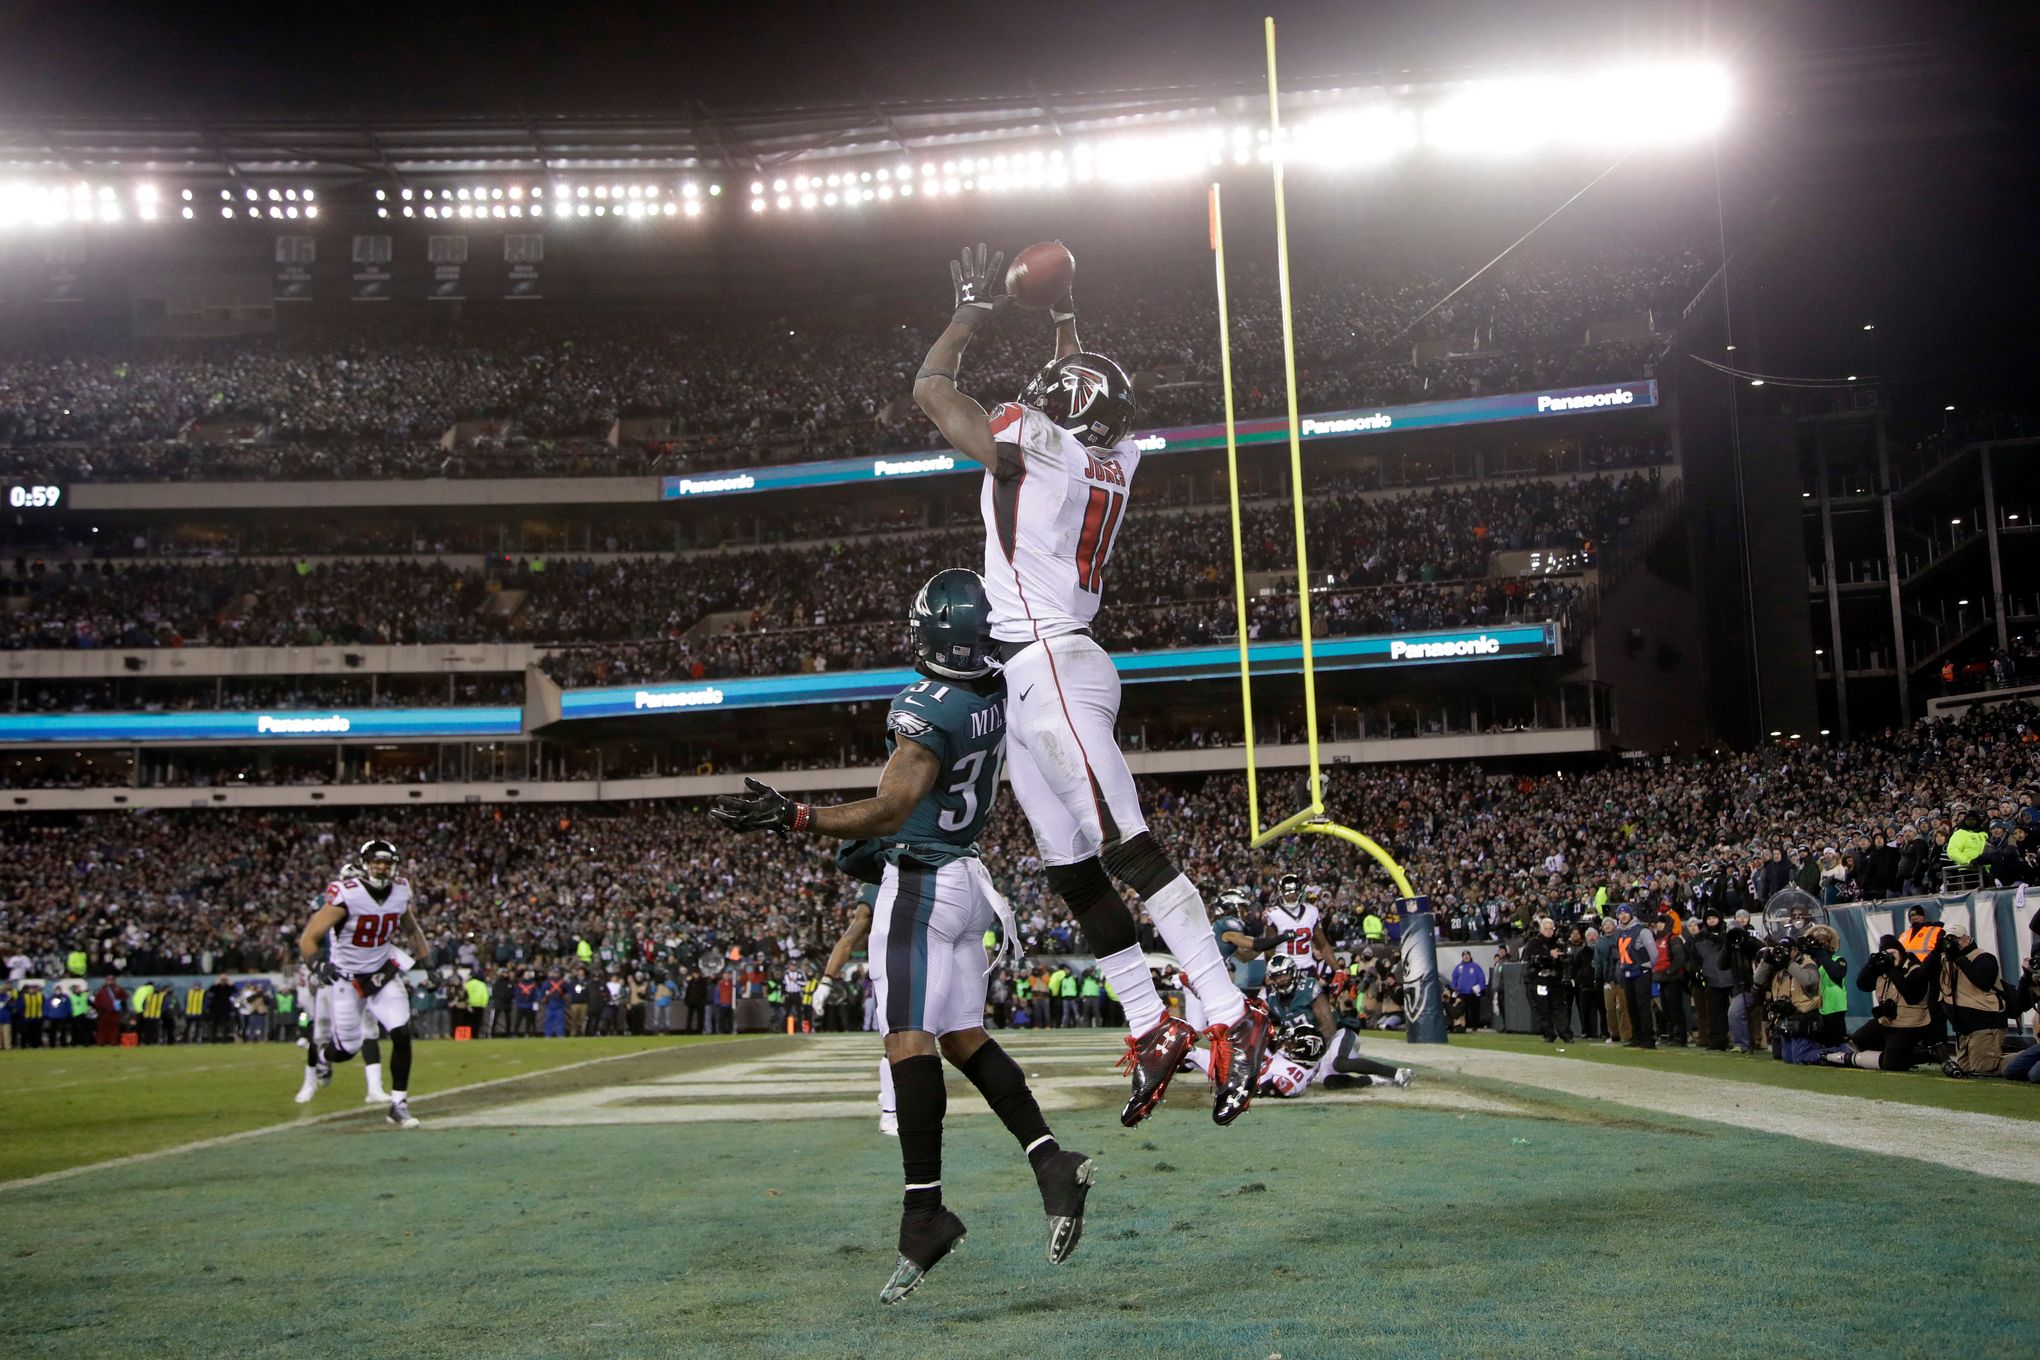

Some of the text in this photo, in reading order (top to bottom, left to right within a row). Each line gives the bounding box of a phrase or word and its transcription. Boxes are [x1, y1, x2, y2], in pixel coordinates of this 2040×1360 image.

[1537, 389, 1634, 412] Panasonic
[1302, 413, 1392, 435] Panasonic
[874, 455, 954, 476] Panasonic
[1085, 456, 1126, 487] JONES
[679, 474, 755, 495] Panasonic
[9, 485, 61, 508] 0:59
[1075, 485, 1124, 595] 11
[1390, 635, 1500, 660] Panasonic
[635, 687, 723, 709] Panasonic
[258, 715, 350, 734] Panasonic
[352, 912, 400, 948] 80
[1286, 927, 1312, 956] 12
[1618, 936, 1634, 964] K
[1286, 1066, 1305, 1084] 40
